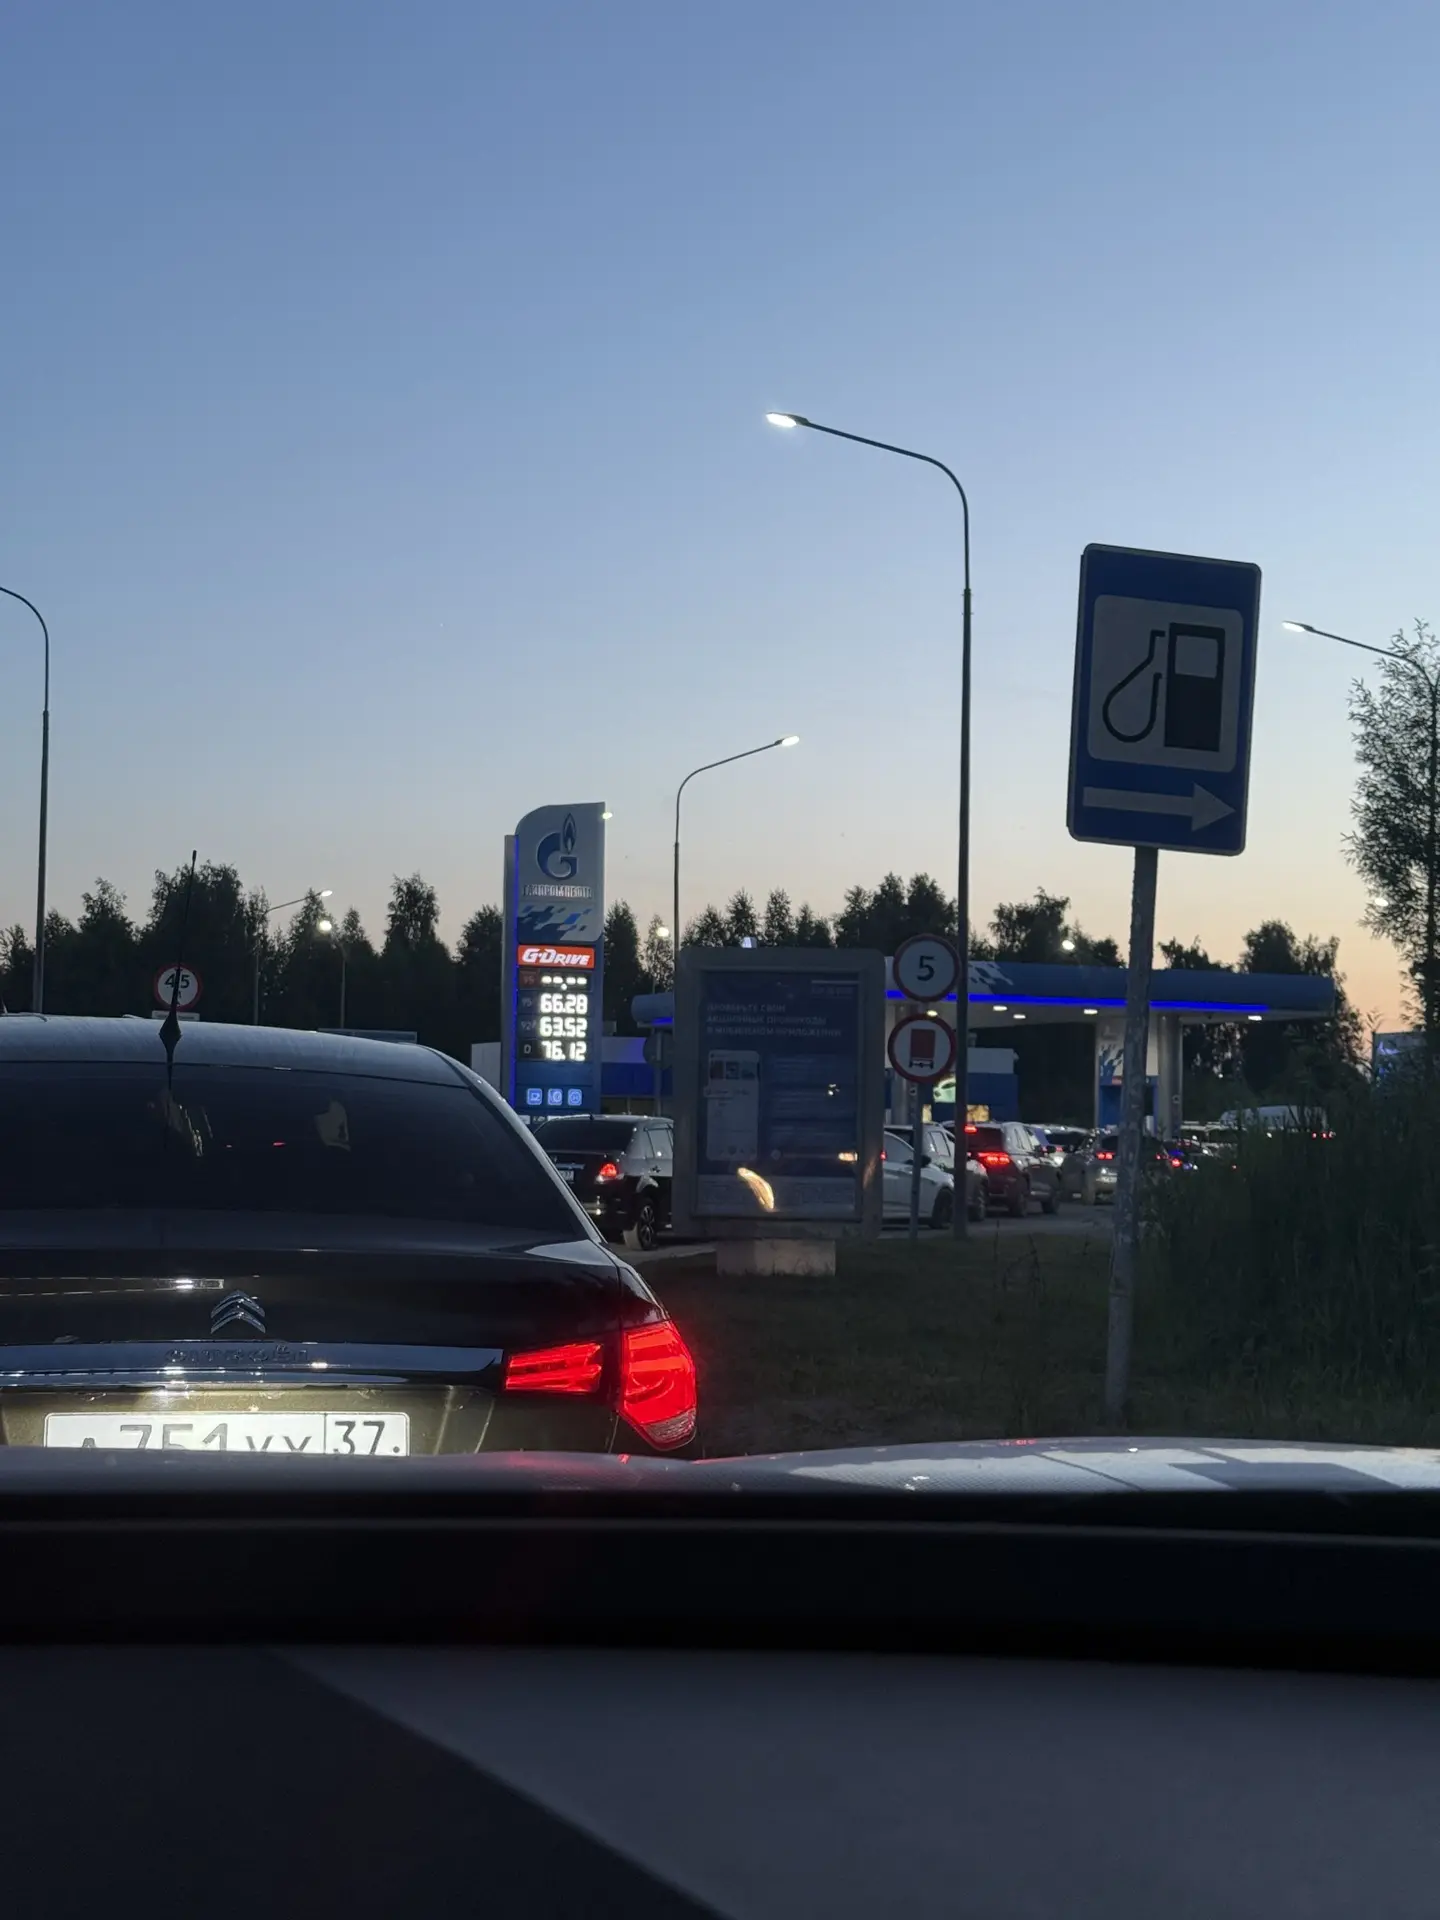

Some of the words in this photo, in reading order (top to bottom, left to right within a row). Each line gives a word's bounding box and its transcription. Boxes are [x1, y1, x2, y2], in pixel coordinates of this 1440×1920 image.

[917, 955, 934, 982] 5
[540, 993, 588, 1014] 66.28
[540, 1016, 588, 1038] 63.52
[541, 1040, 587, 1062] 76.12
[332, 1420, 387, 1454] 37
